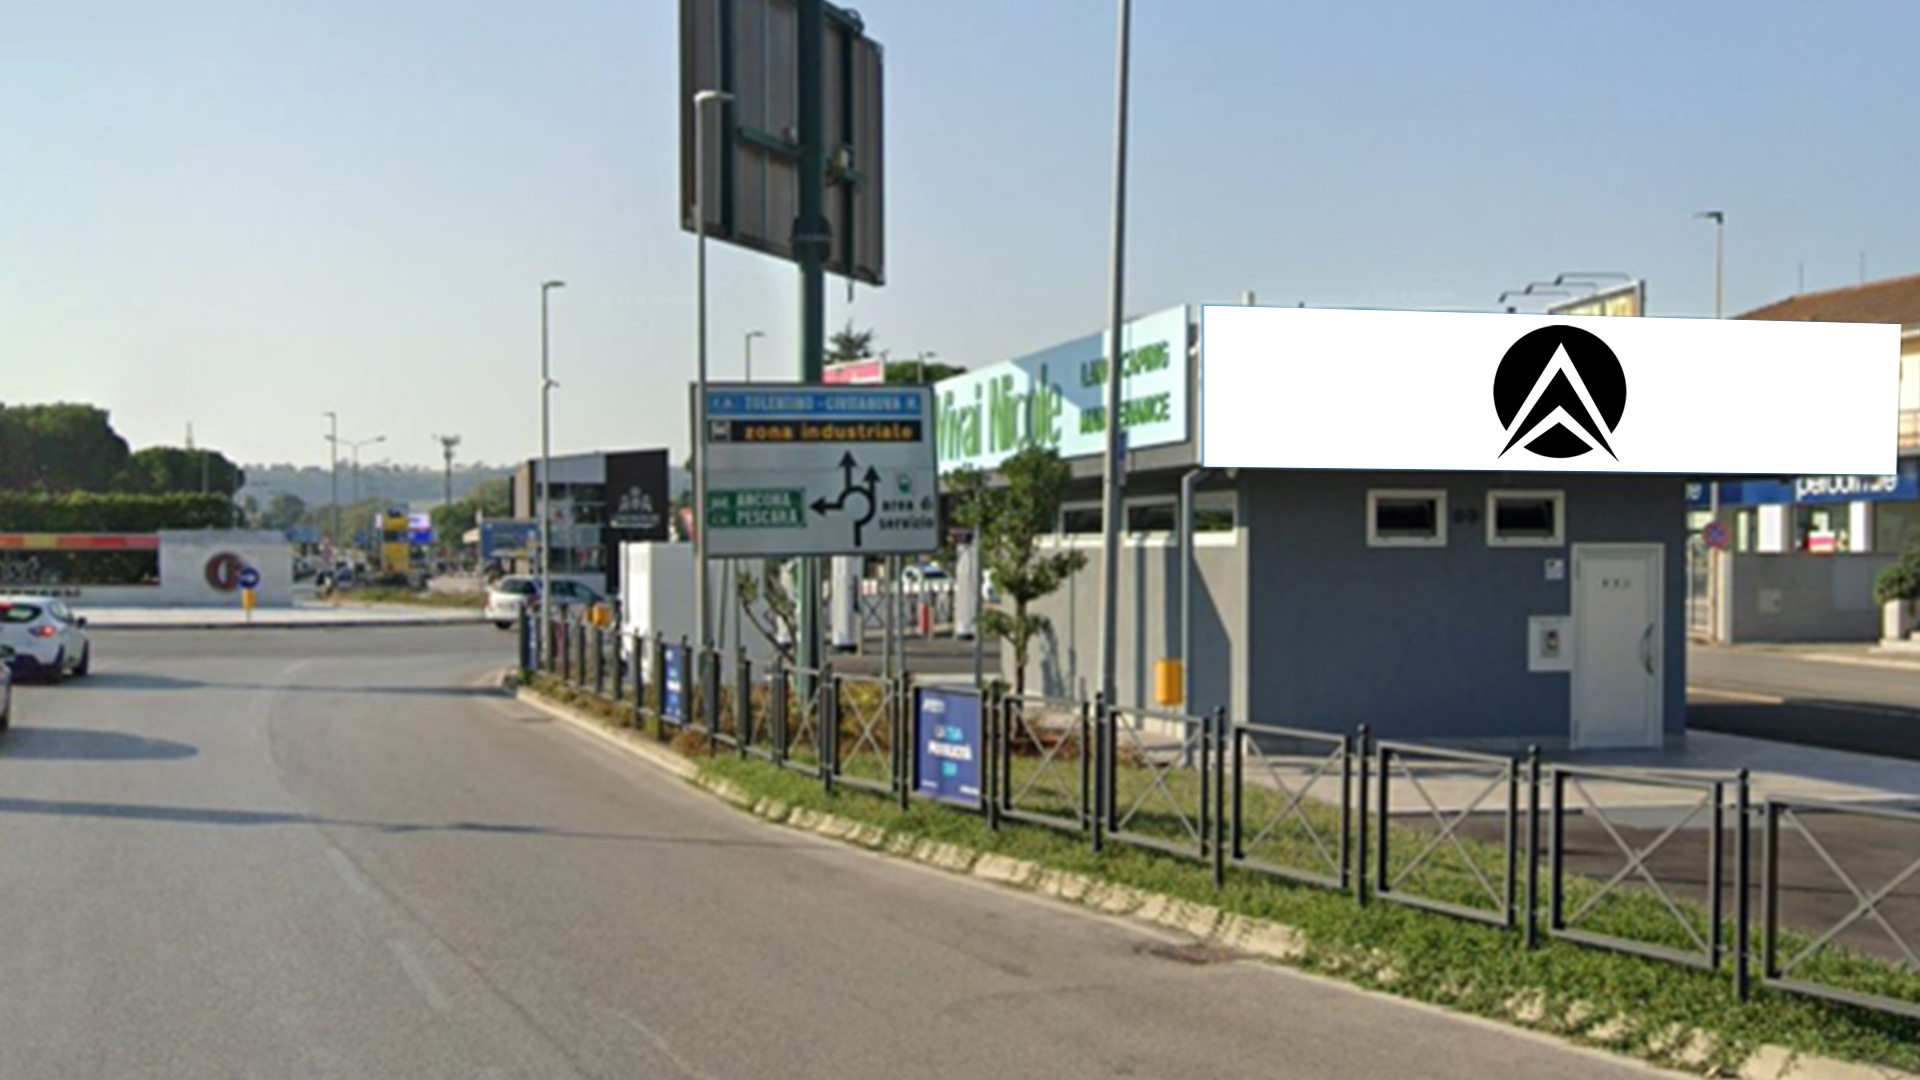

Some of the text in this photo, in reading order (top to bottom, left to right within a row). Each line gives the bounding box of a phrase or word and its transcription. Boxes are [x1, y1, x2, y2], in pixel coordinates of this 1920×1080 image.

[1080, 341, 1170, 388] LANCAPING
[744, 394, 814, 410] TOLENTINO
[825, 394, 901, 411] CIVITANOVA
[936, 362, 1062, 461] Vivai Nicole
[744, 423, 913, 440] zona industriale
[736, 493, 791, 507] ANCONA
[882, 499, 914, 511] area
[736, 508, 798, 525] PESCARA
[879, 516, 934, 531] servizio
